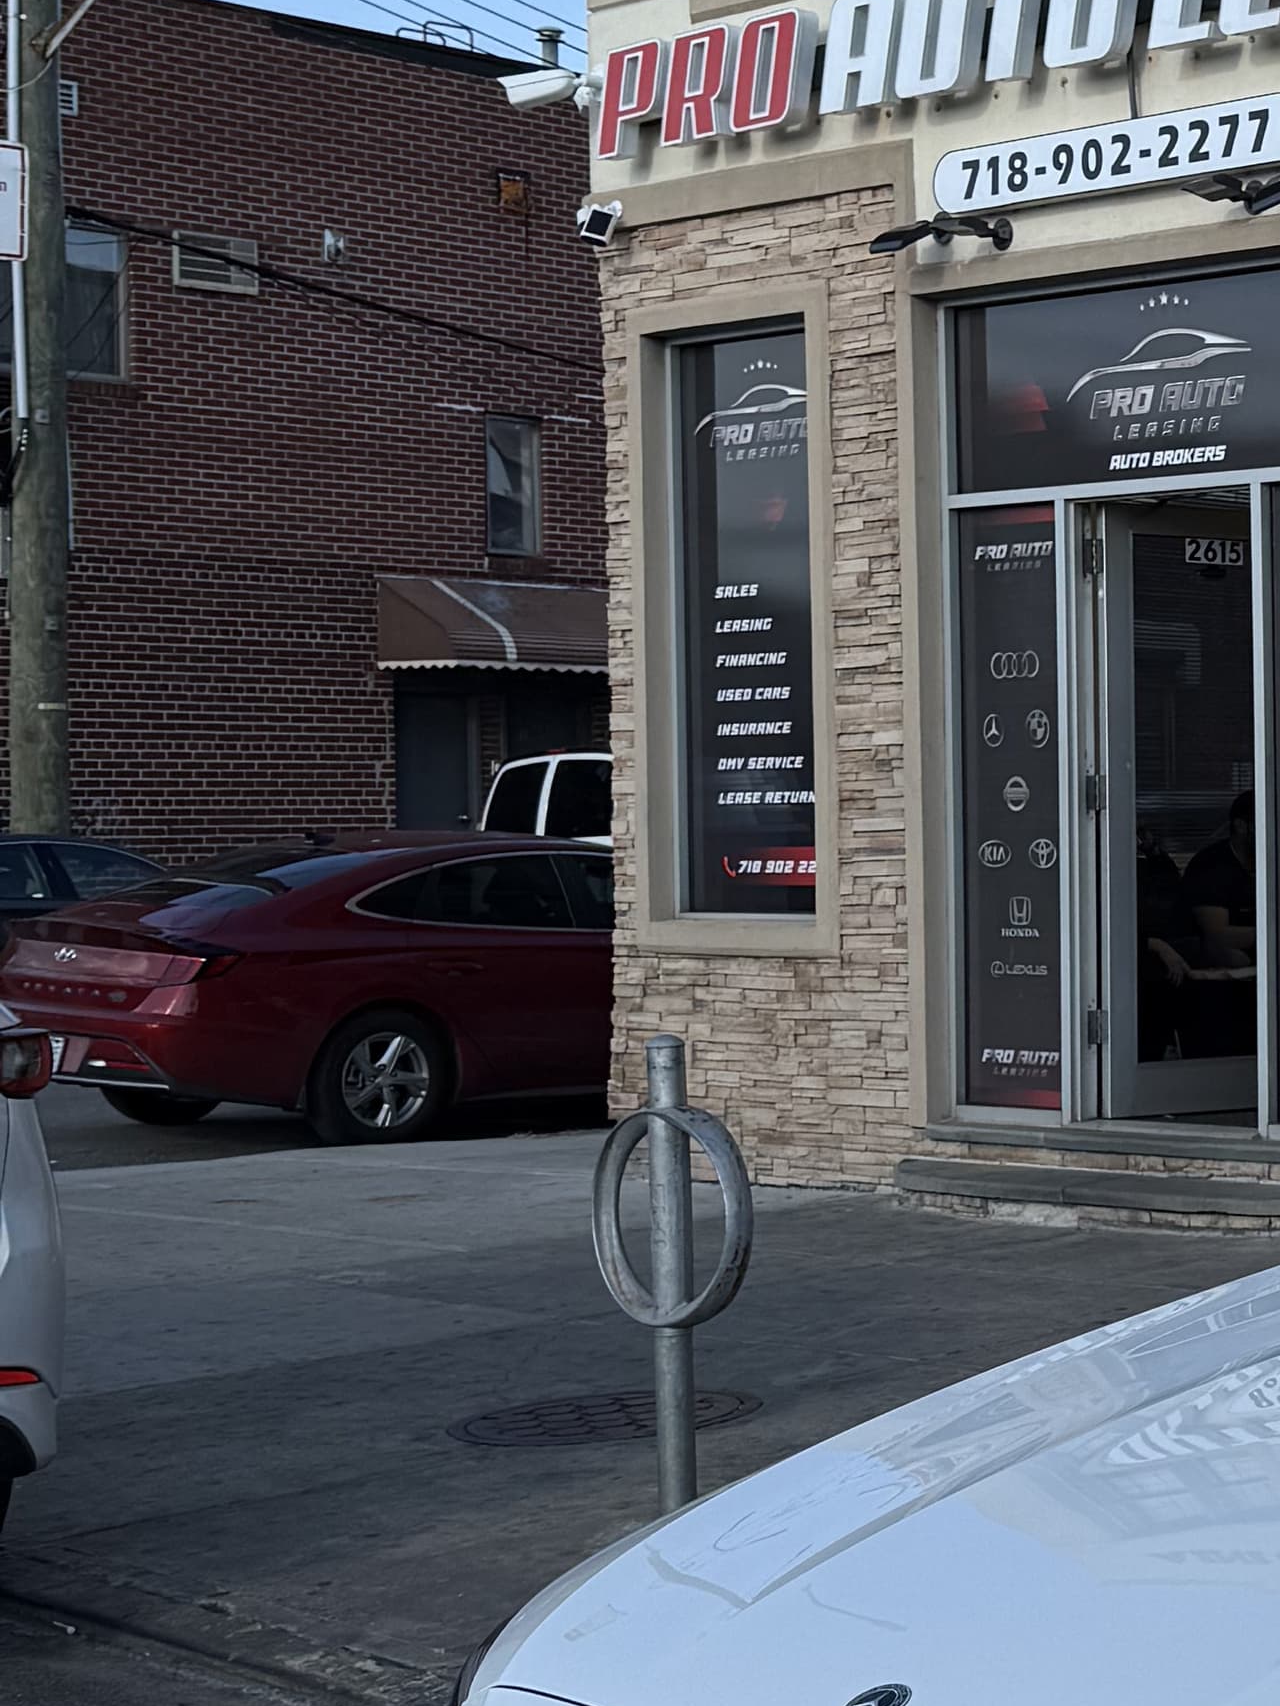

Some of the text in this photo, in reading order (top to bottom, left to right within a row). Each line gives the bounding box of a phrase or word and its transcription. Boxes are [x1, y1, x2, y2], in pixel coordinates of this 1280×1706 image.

[597, 7, 818, 160] PRO
[960, 109, 1271, 200] 718-902-2277
[1090, 375, 1246, 420] PRO AUTO
[709, 422, 754, 447] PRO
[1113, 415, 1222, 441] LEASING
[1109, 445, 1227, 471] AUTO BROKERS
[974, 540, 1053, 560] PRO AUTO
[1187, 539, 1242, 564] 2615
[714, 584, 759, 599] SALES
[715, 618, 773, 634] LEASING
[716, 651, 787, 668] FINANCING
[716, 687, 791, 702] USED CARS
[717, 721, 792, 736] INSURANCE
[717, 756, 804, 770] DMV SERVICE
[718, 792, 762, 805] LEASE
[738, 860, 762, 874] 718
[765, 860, 794, 874] 902
[1001, 928, 1040, 937] HONDA
[1006, 964, 1048, 975] LEXUS
[982, 1048, 1060, 1066] PRO AUTO
